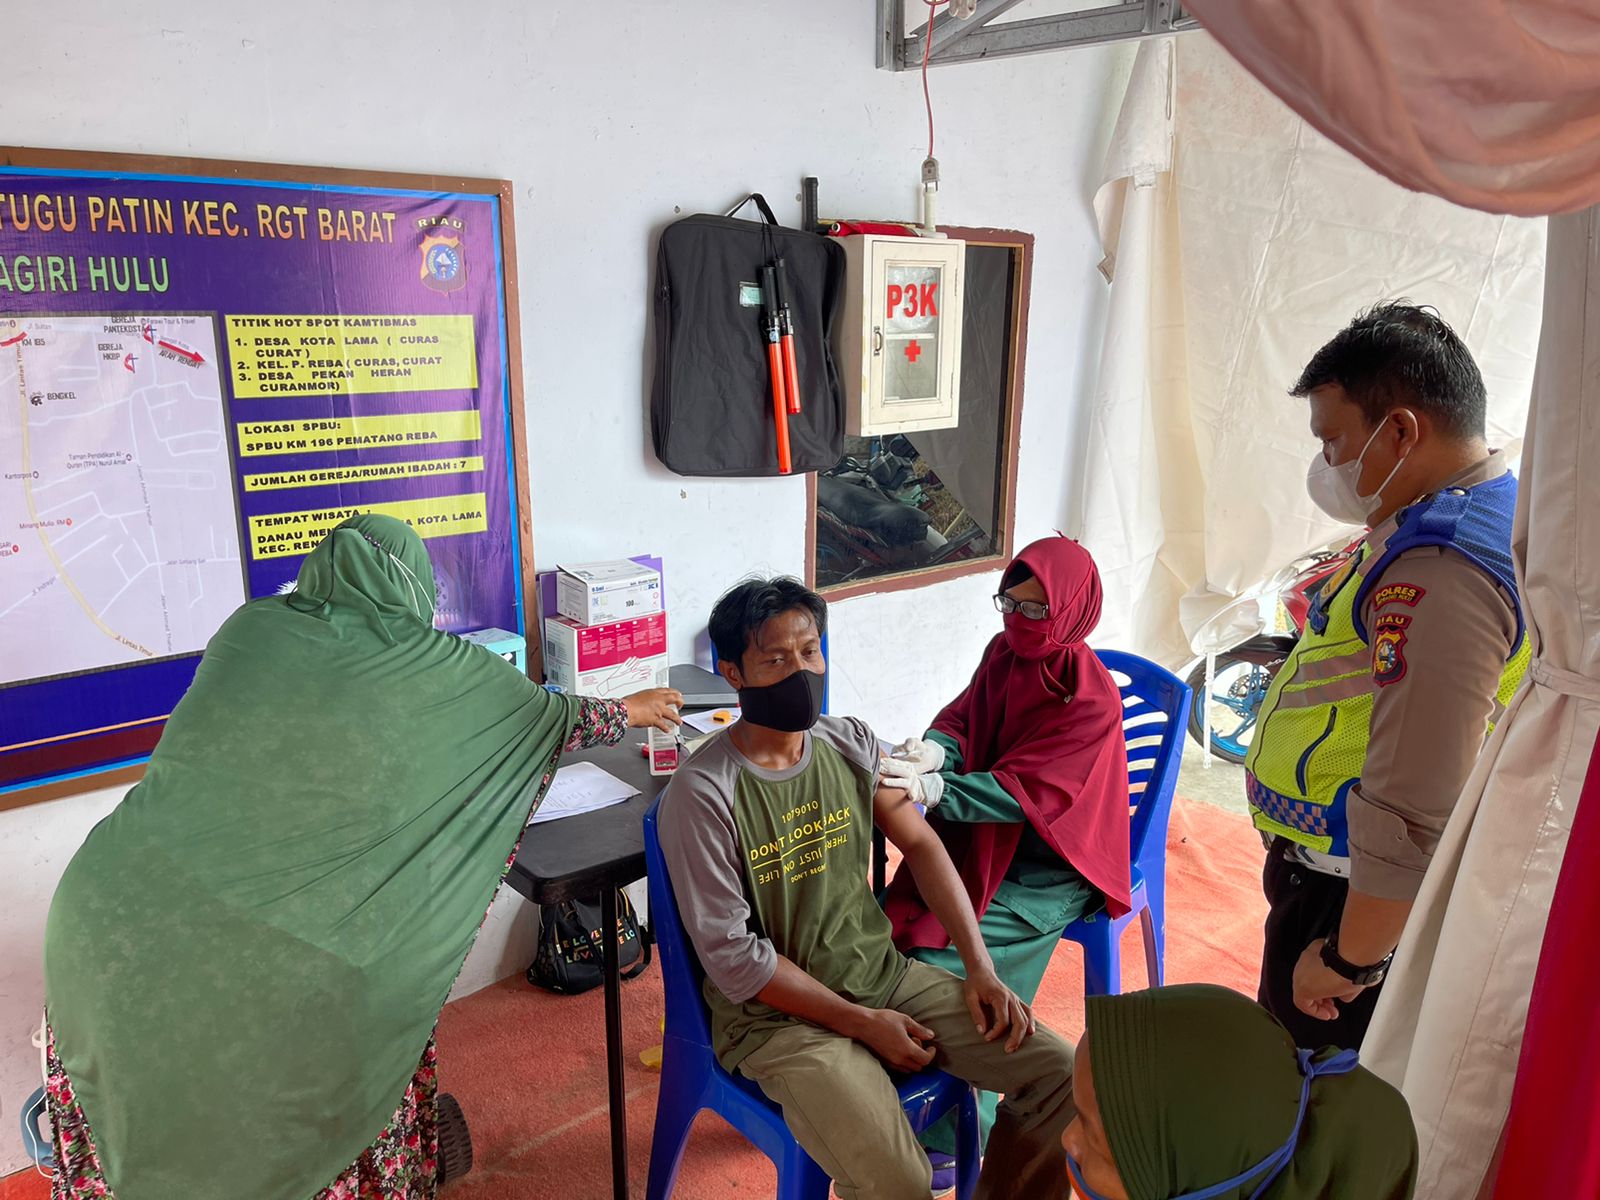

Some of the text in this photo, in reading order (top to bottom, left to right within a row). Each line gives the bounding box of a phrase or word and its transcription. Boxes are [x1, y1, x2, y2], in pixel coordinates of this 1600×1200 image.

[88, 196, 174, 235] PATIN
[183, 200, 249, 237] KEC.
[256, 204, 309, 241] RGT
[317, 208, 396, 243] BARAT
[418, 216, 463, 230] RIAU
[0, 255, 169, 293] AGIRI HULU
[886, 283, 938, 319] P3K
[232, 318, 417, 327] TITIK HOT SPOT KAMTIBMAS
[235, 338, 248, 346] 1.
[254, 338, 290, 346] DESA
[300, 337, 335, 345] KOTA
[344, 336, 379, 345] LAMA
[400, 335, 439, 344] CURAS
[255, 349, 302, 358] CURAT
[237, 361, 250, 370] 2.
[257, 361, 289, 369] KEL.
[292, 360, 305, 368] P.
[308, 360, 343, 368] REBA
[239, 368, 411, 381] 3. DESA PEKAN HERAN
[259, 382, 340, 392] CURANMOR)
[47, 392, 77, 400] BENGKEL
[244, 422, 341, 434] LOKASI SPBU:
[246, 431, 438, 452] SPBU KM 196 PEMATANG REBA
[250, 474, 306, 487] JUMLAH
[408, 462, 451, 473] IBADAH
[255, 514, 309, 528] TEMPAT
[311, 509, 360, 521] WISATA
[417, 514, 448, 525] KOTA
[452, 511, 482, 520] LAMA
[257, 531, 303, 544] DANAU
[258, 544, 291, 555] KEC.
[1375, 586, 1417, 602] POLRES
